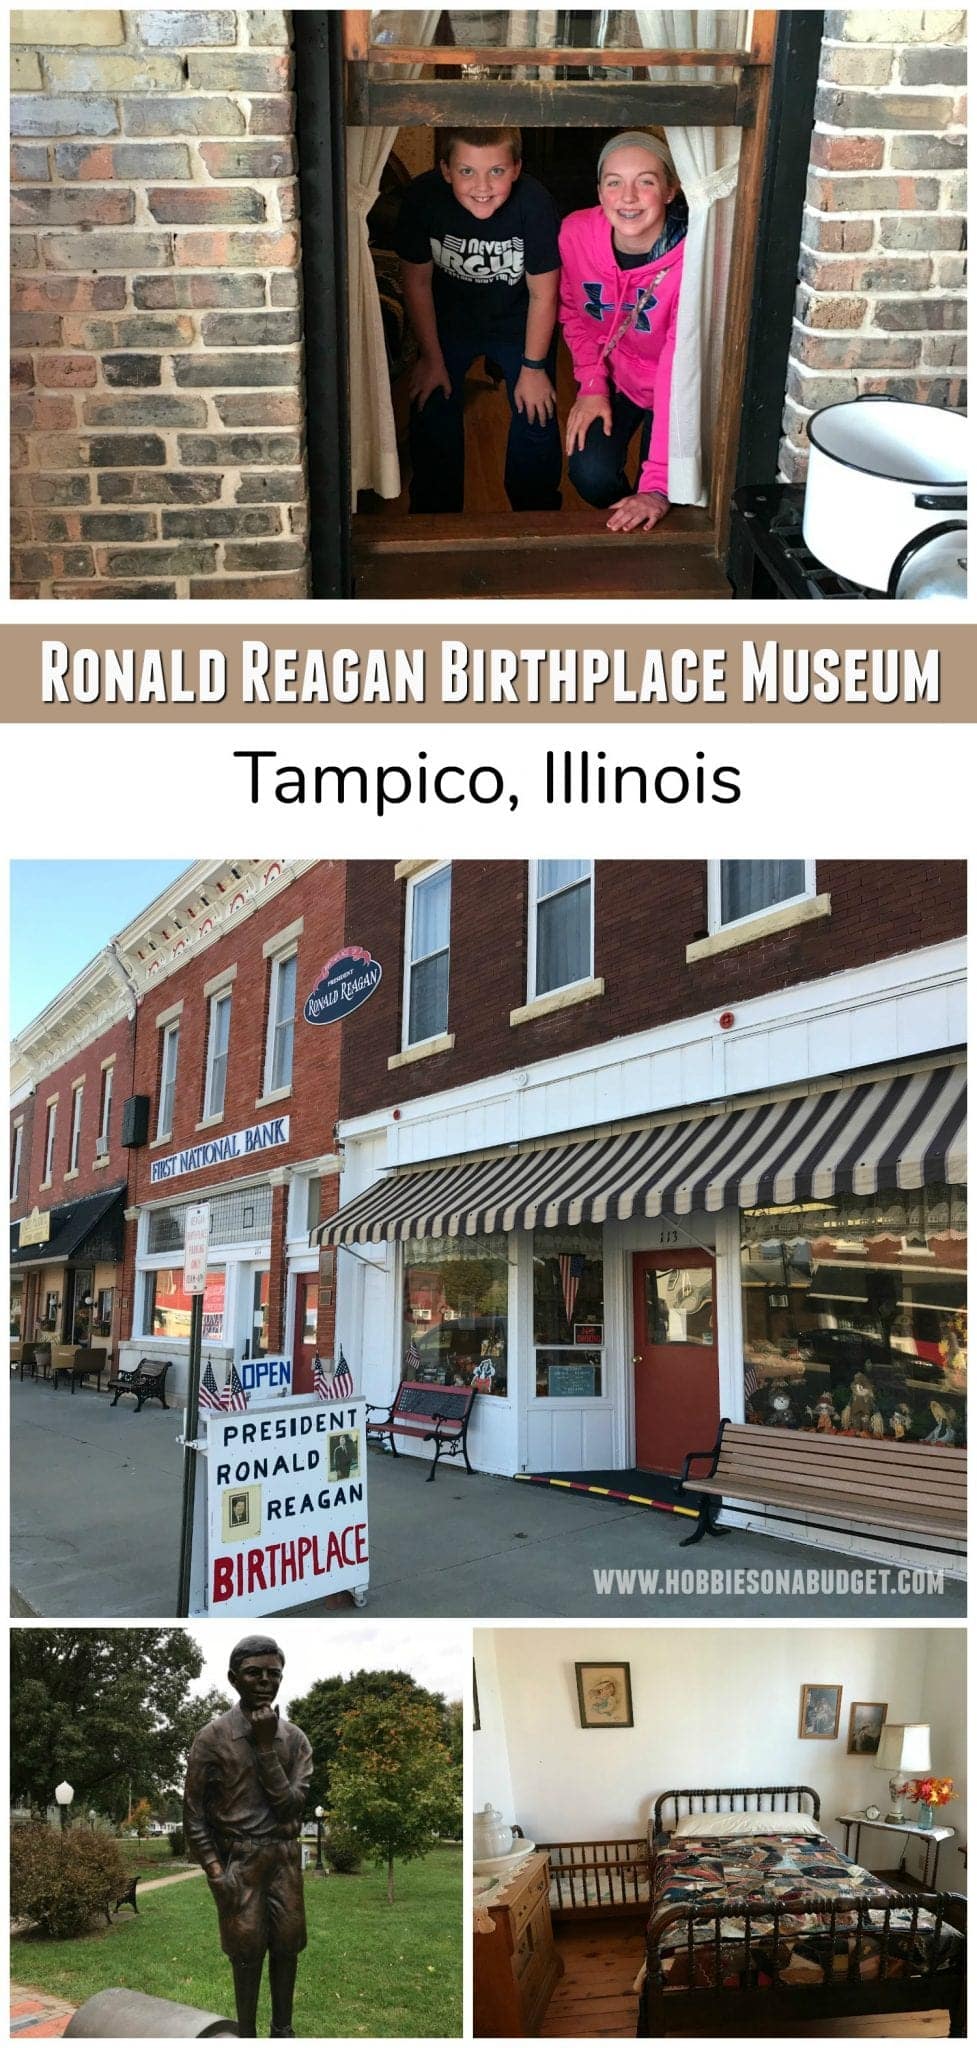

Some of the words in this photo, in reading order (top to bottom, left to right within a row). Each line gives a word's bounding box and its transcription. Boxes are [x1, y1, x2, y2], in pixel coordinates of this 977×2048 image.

[308, 990, 339, 1017] RONALD
[341, 968, 378, 1001] REAGAN
[152, 1156, 177, 1181] FIRST
[180, 1135, 240, 1172] NATIONAL
[245, 1118, 286, 1152] BANK
[660, 1230, 678, 1243] 113
[242, 1361, 291, 1390] OPEN
[224, 1409, 357, 1447] PRESIDENT
[217, 1450, 320, 1485] RONALD
[267, 1483, 363, 1521] REAGAN
[213, 1523, 369, 1603] BIRTHPLACE
